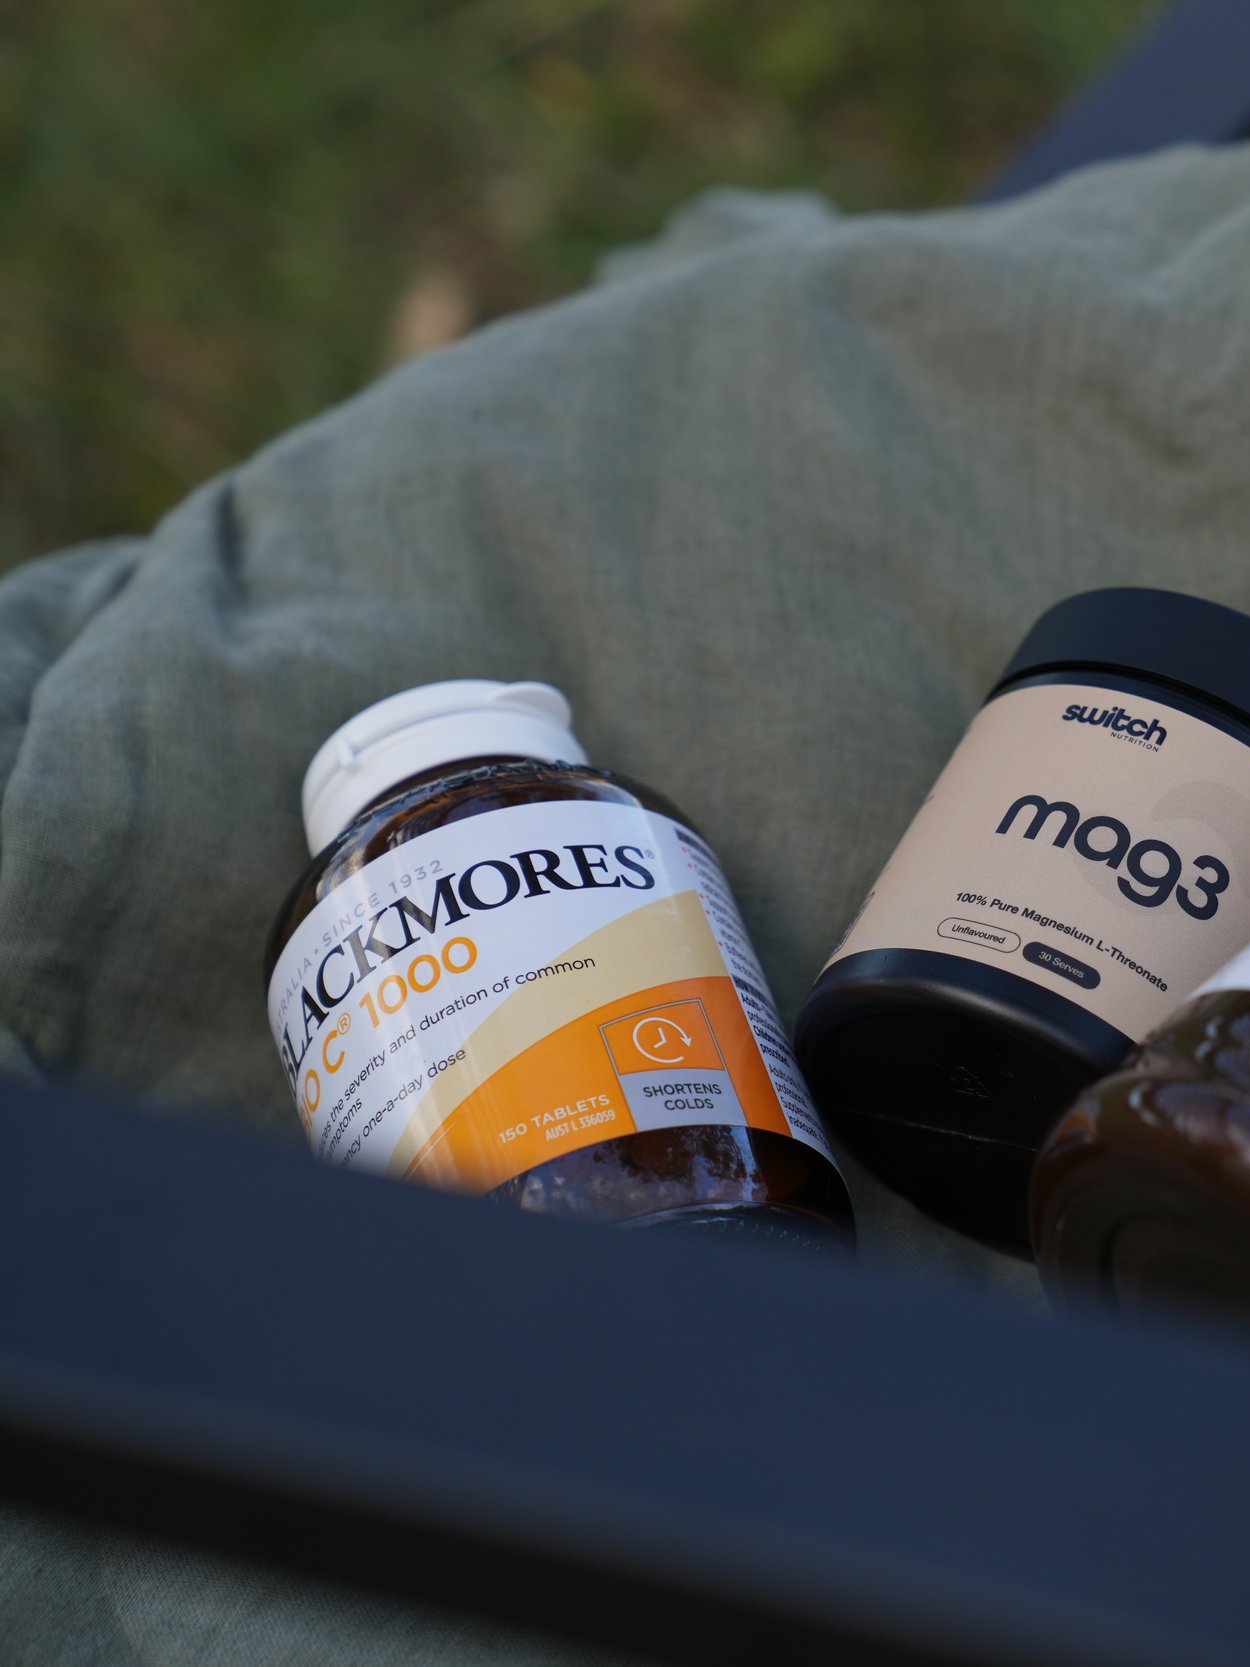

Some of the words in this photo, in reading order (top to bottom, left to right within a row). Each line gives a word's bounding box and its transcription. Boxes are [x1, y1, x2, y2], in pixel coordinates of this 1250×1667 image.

[1062, 704, 1167, 746] switch
[1110, 731, 1160, 753] NUTRITION
[995, 794, 1230, 920] mag3
[322, 893, 380, 947] SINCE
[388, 860, 443, 894] 1932
[951, 923, 1006, 945] Unflavoured
[956, 892, 987, 906] 100%
[989, 898, 1019, 915] Pure
[1021, 907, 1095, 946] Magnesium
[1096, 940, 1168, 992] L-Threonate
[359, 936, 478, 1029] 1000
[1038, 950, 1052, 962] 30
[1052, 956, 1085, 979] Serves
[330, 1099, 344, 1122] the
[344, 1050, 386, 1101] severity
[389, 1025, 417, 1054] and
[419, 988, 488, 1031] duration
[492, 976, 510, 993] of
[515, 957, 596, 985] common
[362, 1075, 423, 1137] one-a-day
[427, 1049, 466, 1078] dose
[643, 1082, 722, 1098] SHORTENS
[664, 1098, 714, 1111] COLDS
[498, 1122, 528, 1144] 150
[530, 1094, 610, 1128] TABLETS
[545, 1121, 570, 1141] AUST
[572, 1119, 579, 1131] L
[580, 1109, 616, 1129] 336059
